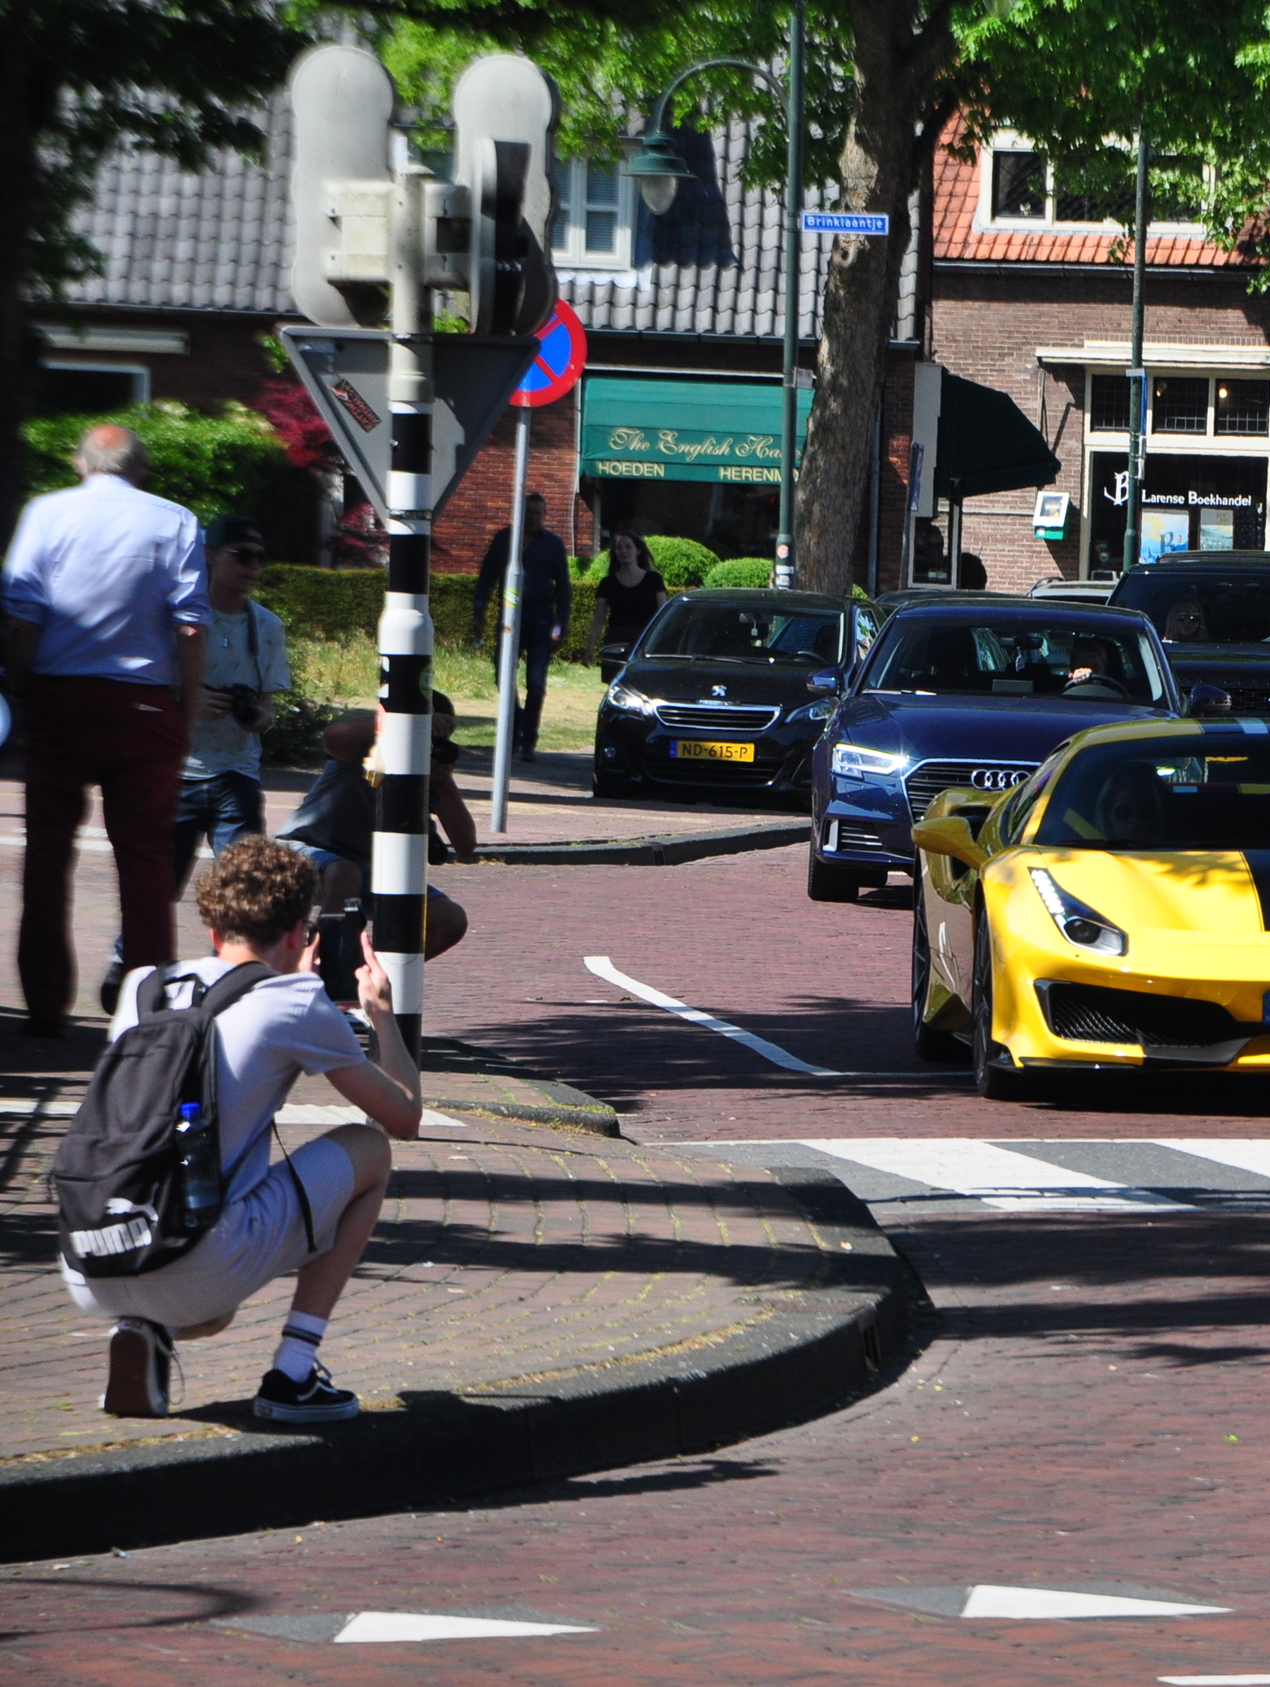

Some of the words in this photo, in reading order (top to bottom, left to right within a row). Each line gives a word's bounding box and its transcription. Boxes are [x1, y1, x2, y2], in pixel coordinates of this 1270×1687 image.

[807, 215, 883, 231] Brinklaantje
[610, 427, 650, 451] The
[656, 429, 733, 462] English
[597, 461, 664, 478] HOEDEN
[1142, 489, 1185, 505] Larense
[1188, 490, 1252, 506] Boekhandel
[682, 743, 748, 759] ND-615-P
